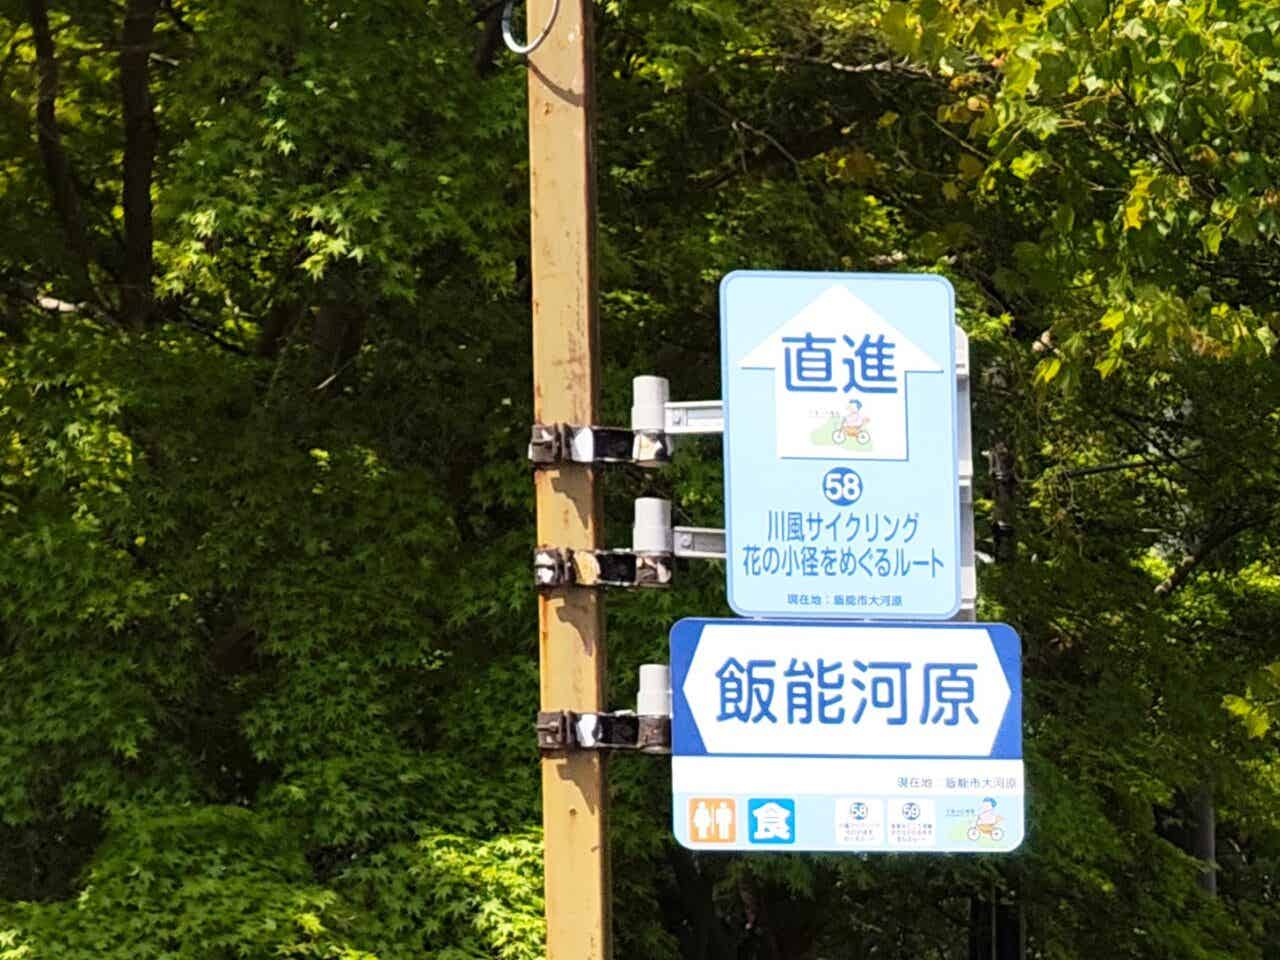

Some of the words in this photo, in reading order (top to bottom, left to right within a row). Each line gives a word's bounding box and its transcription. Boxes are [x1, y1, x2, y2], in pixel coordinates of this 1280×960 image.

[782, 332, 899, 395] 直進
[824, 473, 861, 501] 58
[766, 510, 920, 543] 川風サイクリング
[742, 544, 945, 580] 花の小径をめぐるルート
[715, 656, 980, 726] 飯能河原
